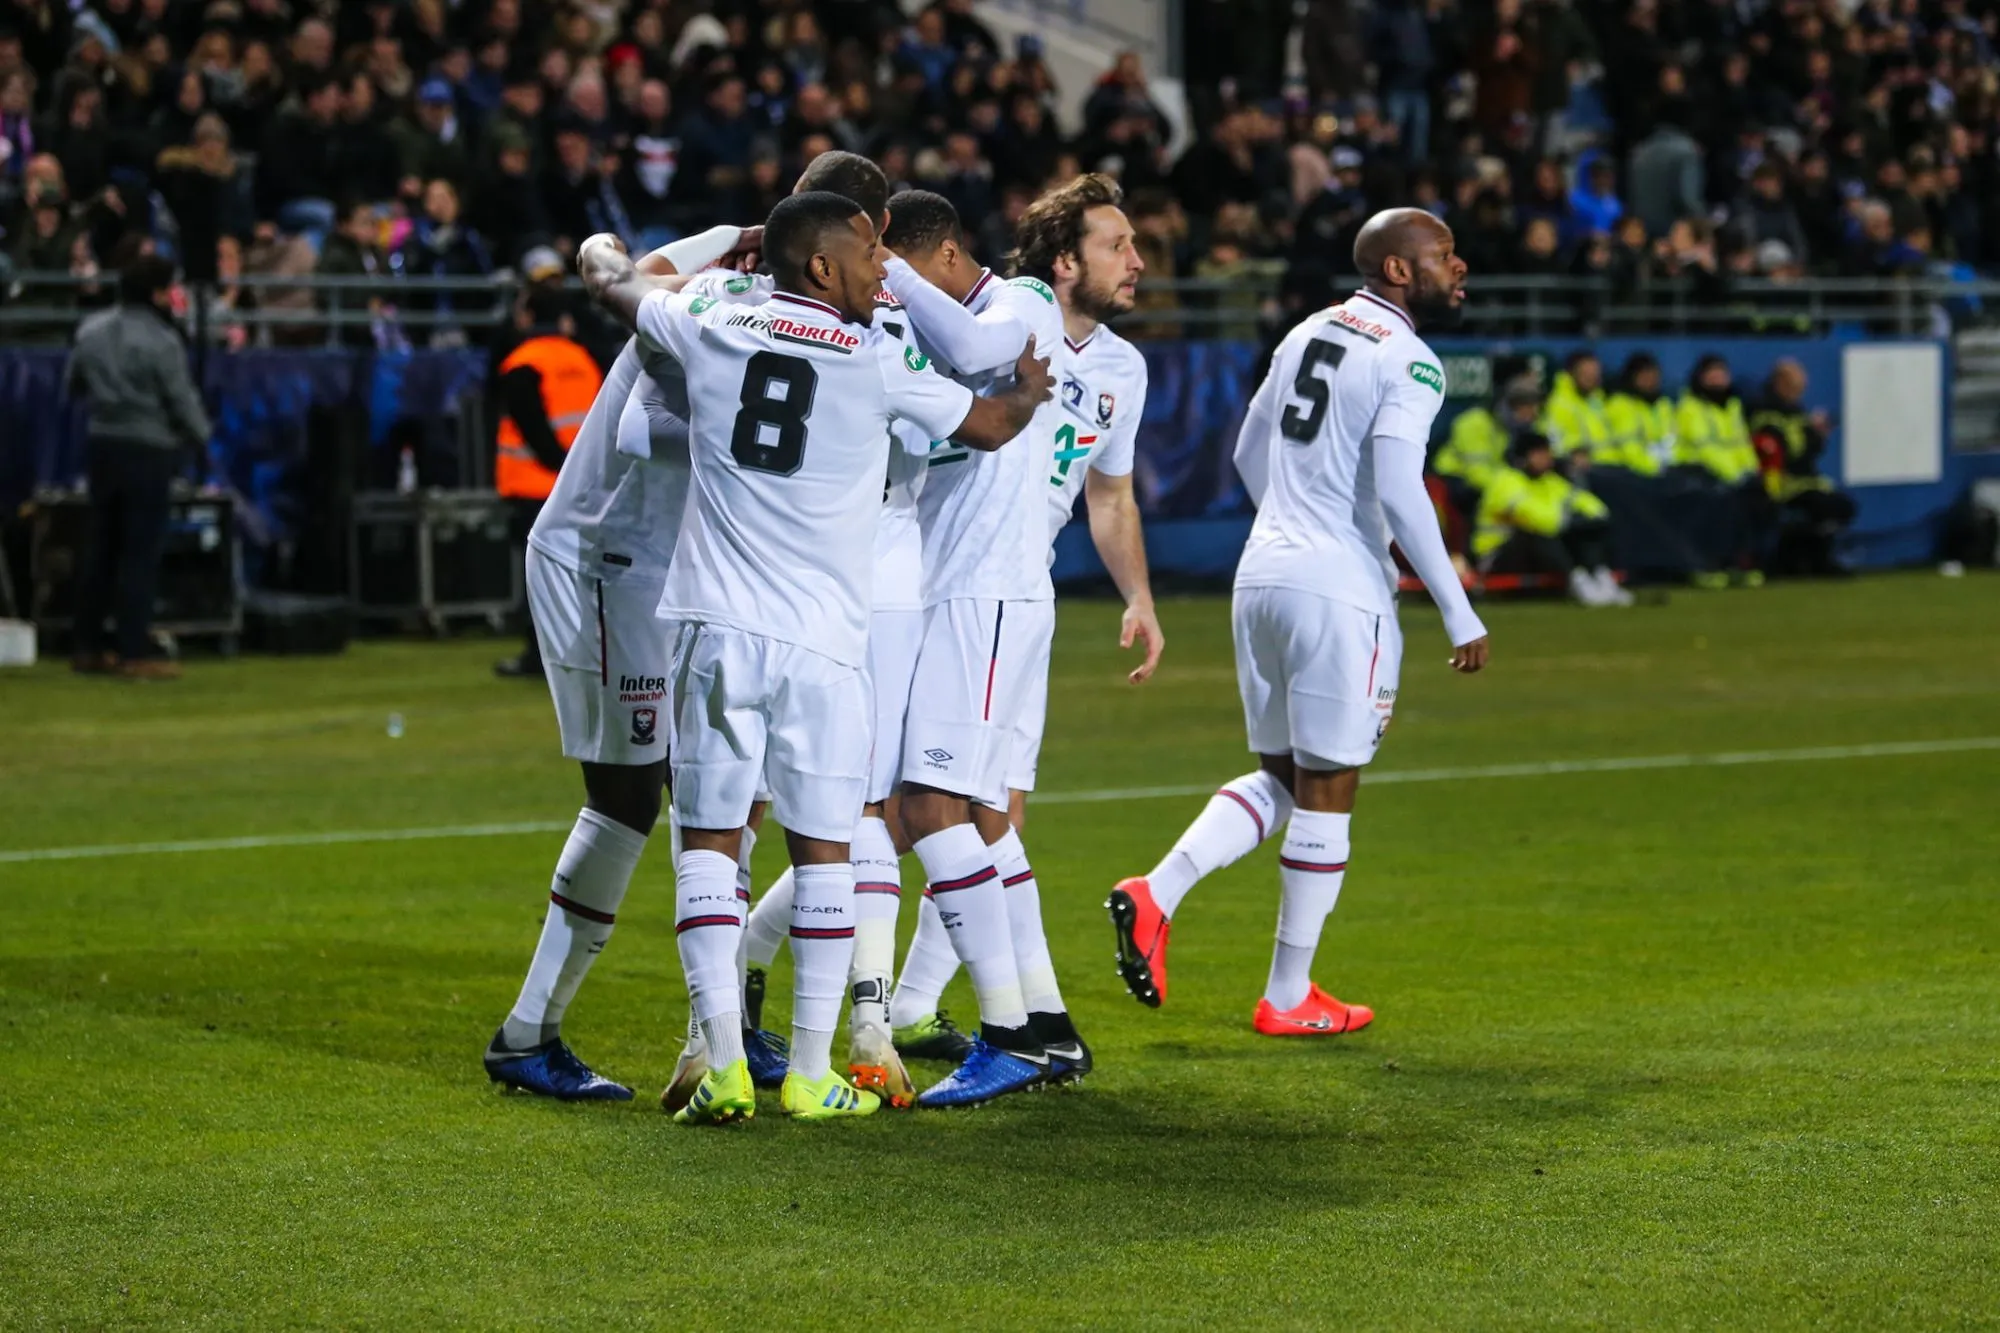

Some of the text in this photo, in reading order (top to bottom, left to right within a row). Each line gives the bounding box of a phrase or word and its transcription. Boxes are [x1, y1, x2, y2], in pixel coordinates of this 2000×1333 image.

[730, 350, 819, 477] 8
[1281, 337, 1348, 444] 5
[800, 905, 844, 914] CAEN
